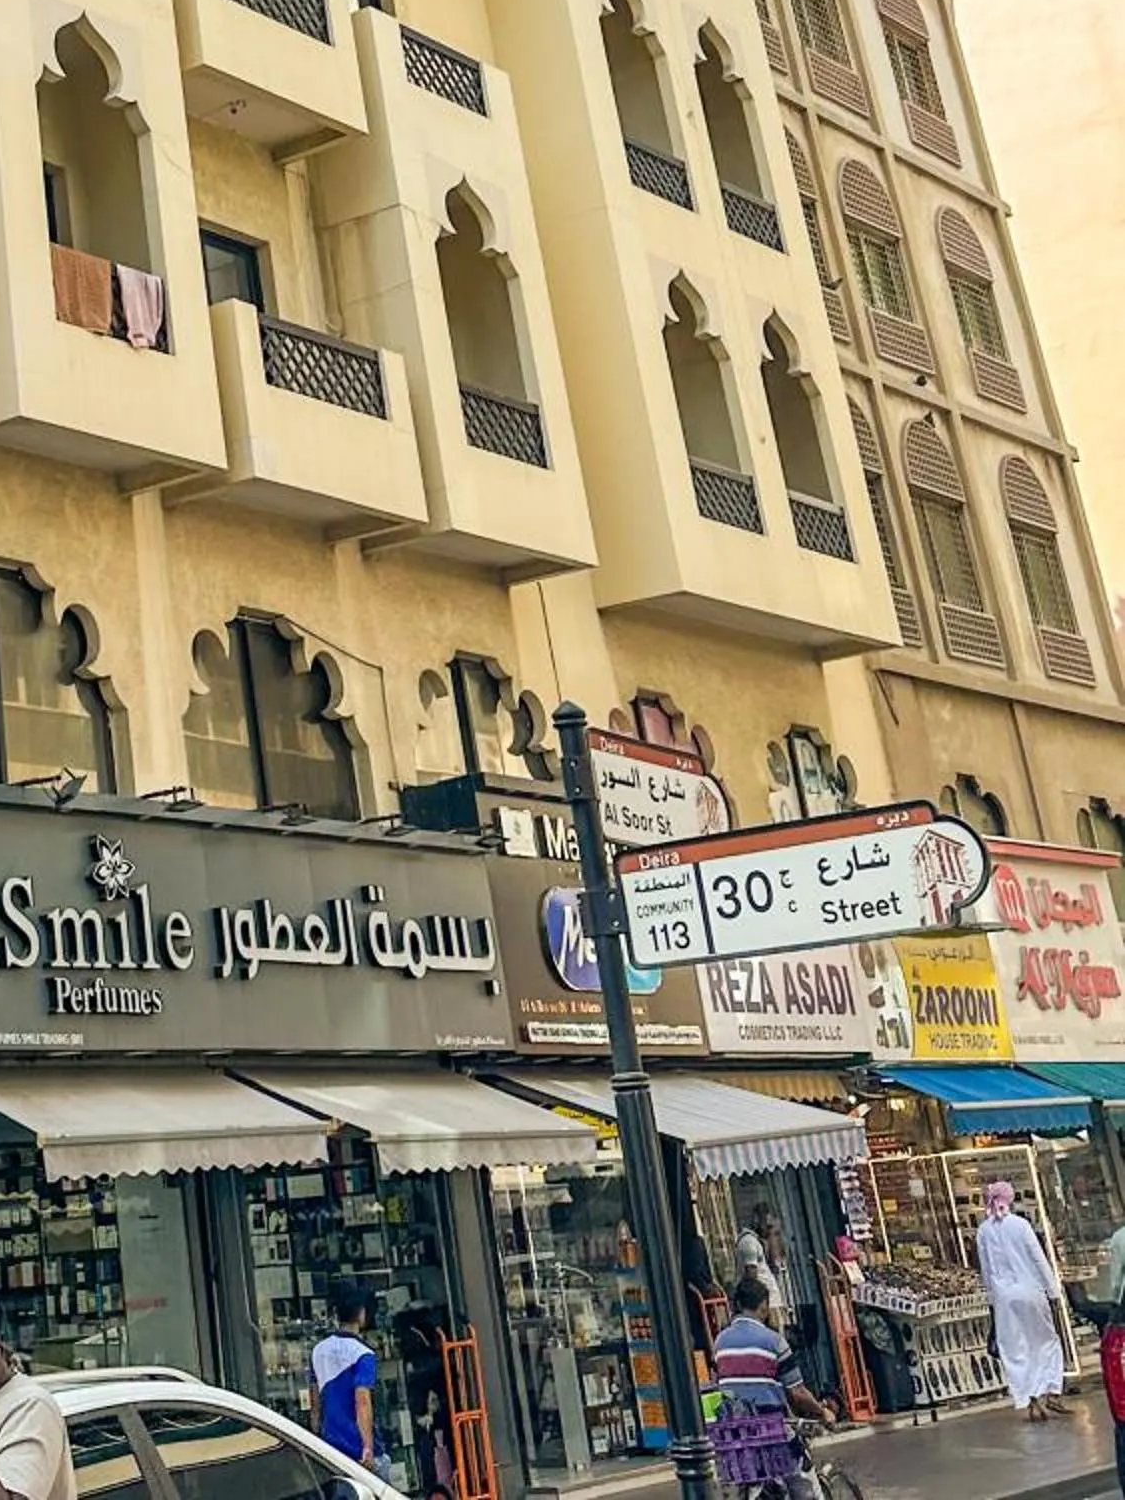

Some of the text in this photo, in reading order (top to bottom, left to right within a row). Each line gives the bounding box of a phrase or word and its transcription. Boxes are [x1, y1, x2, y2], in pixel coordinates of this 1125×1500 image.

[600, 765, 686, 802] شارع السور
[604, 801, 620, 826] Al
[621, 806, 654, 832] Soor
[638, 851, 681, 869] Deira
[817, 843, 890, 887] شارع
[634, 872, 691, 894] المنطقة
[712, 869, 774, 920] 30
[1, 876, 195, 970] Smile
[636, 899, 694, 919] COMMUNITY
[821, 890, 903, 925] Street
[218, 899, 361, 981] العطور
[367, 884, 502, 997] بسمة
[648, 920, 691, 953] 113
[54, 976, 164, 1015] Perfumes
[706, 960, 856, 1016] REZA ASADI
[912, 984, 1000, 1027] ZAROONI
